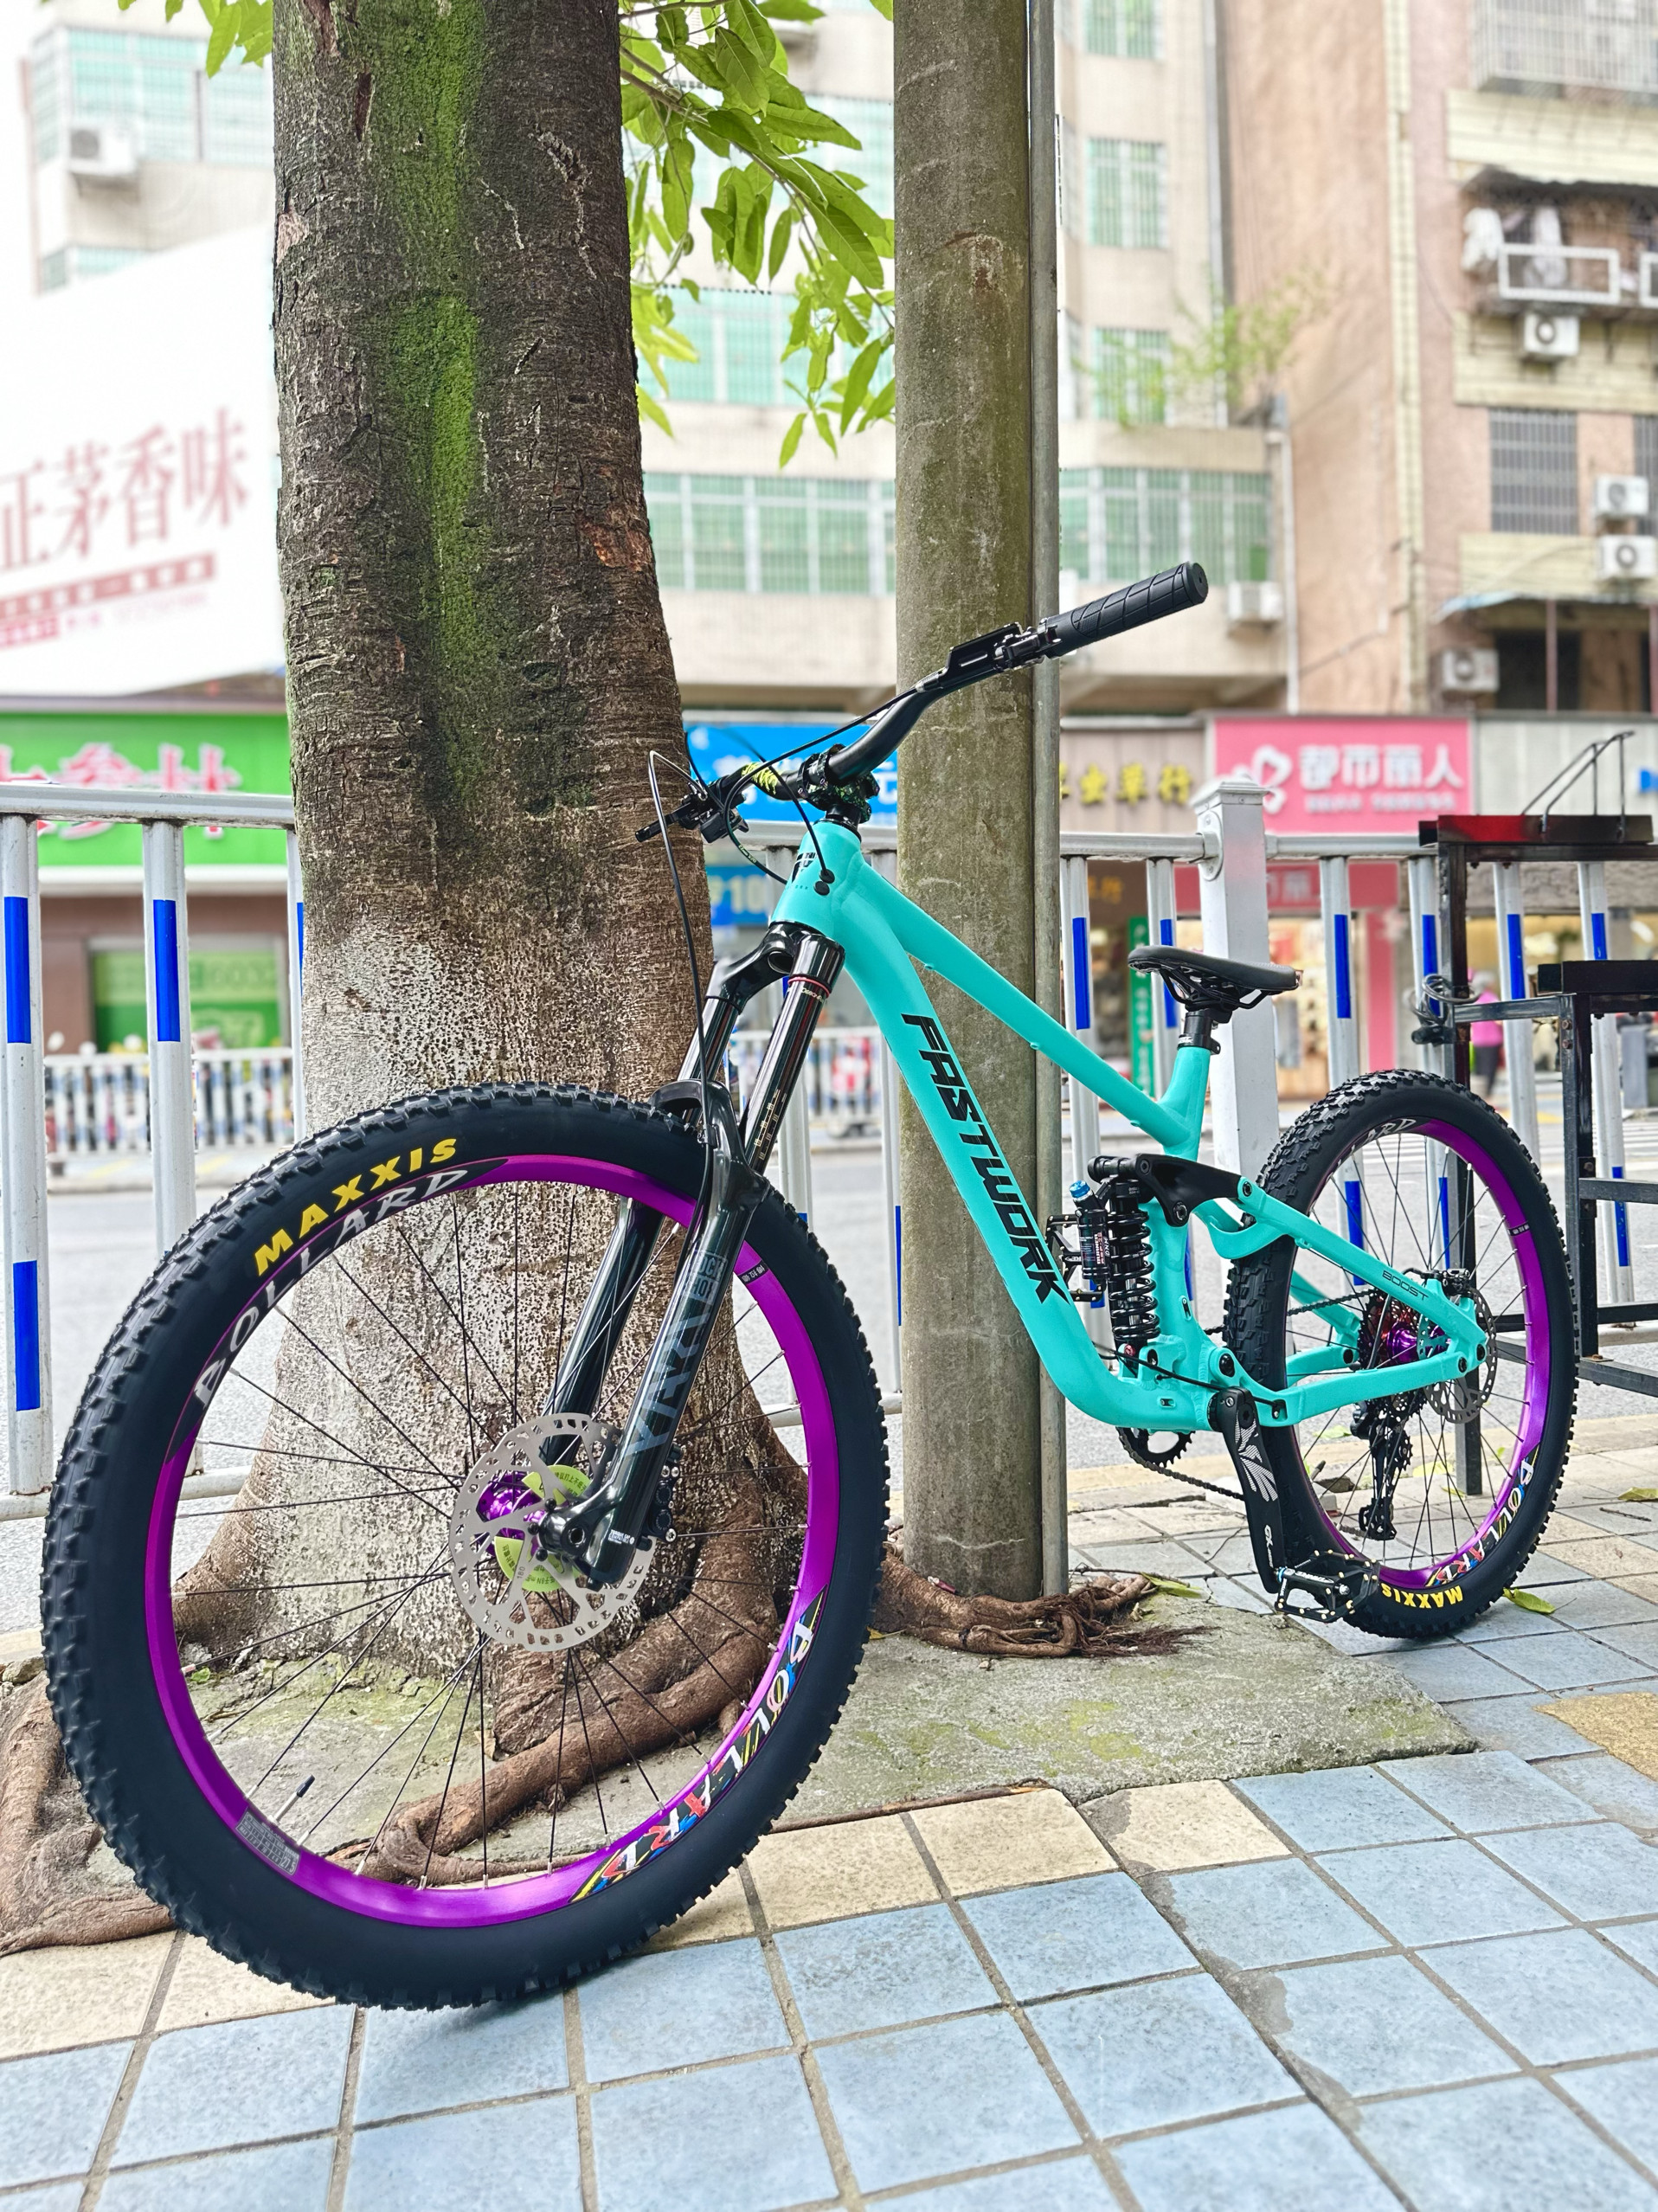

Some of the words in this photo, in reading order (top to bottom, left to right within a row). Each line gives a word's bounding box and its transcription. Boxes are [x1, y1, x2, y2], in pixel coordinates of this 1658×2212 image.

[1299, 743, 1464, 791] 都市丽人
[254, 1138, 457, 1276] MAXXIS
[901, 1013, 1070, 1305] FASTWORK
[195, 1169, 468, 1409] BOLLARD
[1382, 1270, 1430, 1302] BOOST
[516, 1566, 526, 1579] 180
[1436, 1459, 1534, 1583] BOLLARD
[1381, 1583, 1463, 1609] MAXXIS
[603, 1621, 814, 1879] BOLLARD
